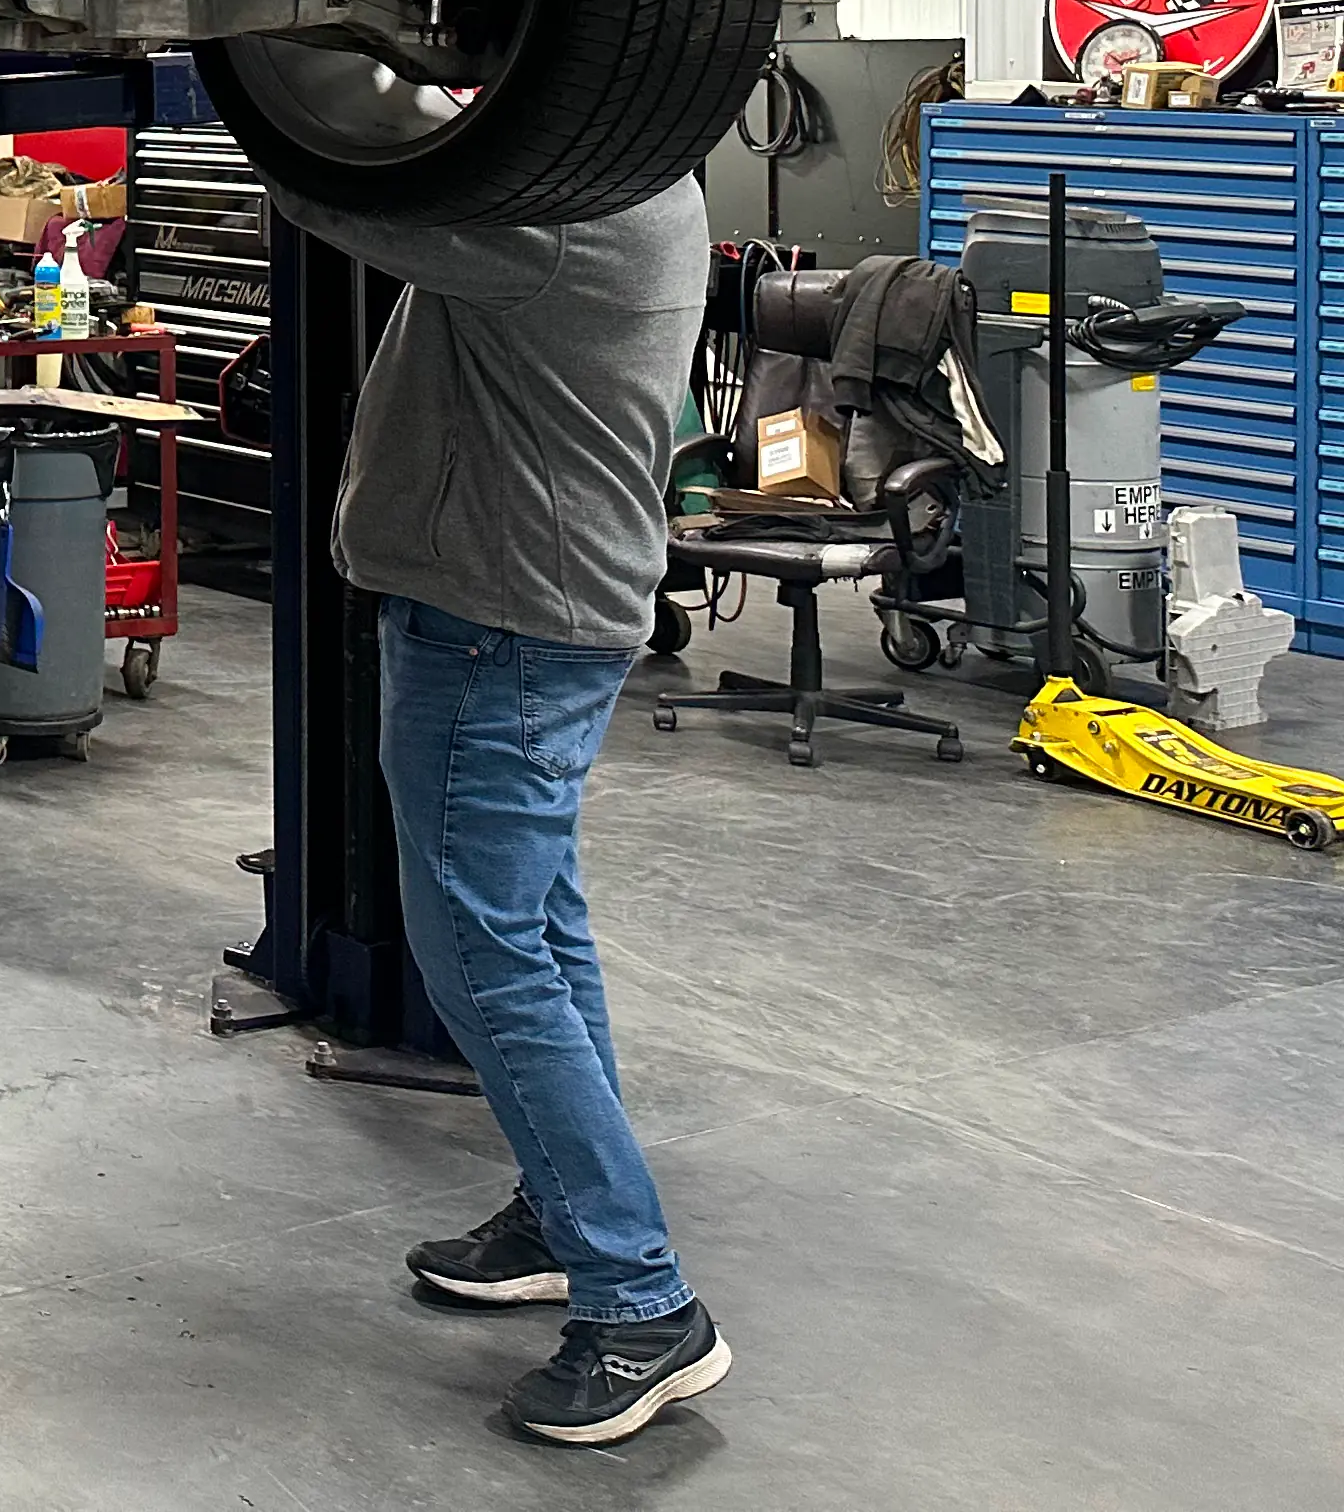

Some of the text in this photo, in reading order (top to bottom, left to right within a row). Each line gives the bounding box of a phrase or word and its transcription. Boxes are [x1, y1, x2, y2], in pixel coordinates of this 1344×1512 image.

[1115, 485, 1160, 505] EMPT
[1124, 504, 1160, 524] HERE
[1119, 570, 1160, 590] EMPT
[1140, 773, 1297, 827] DAYTONA
